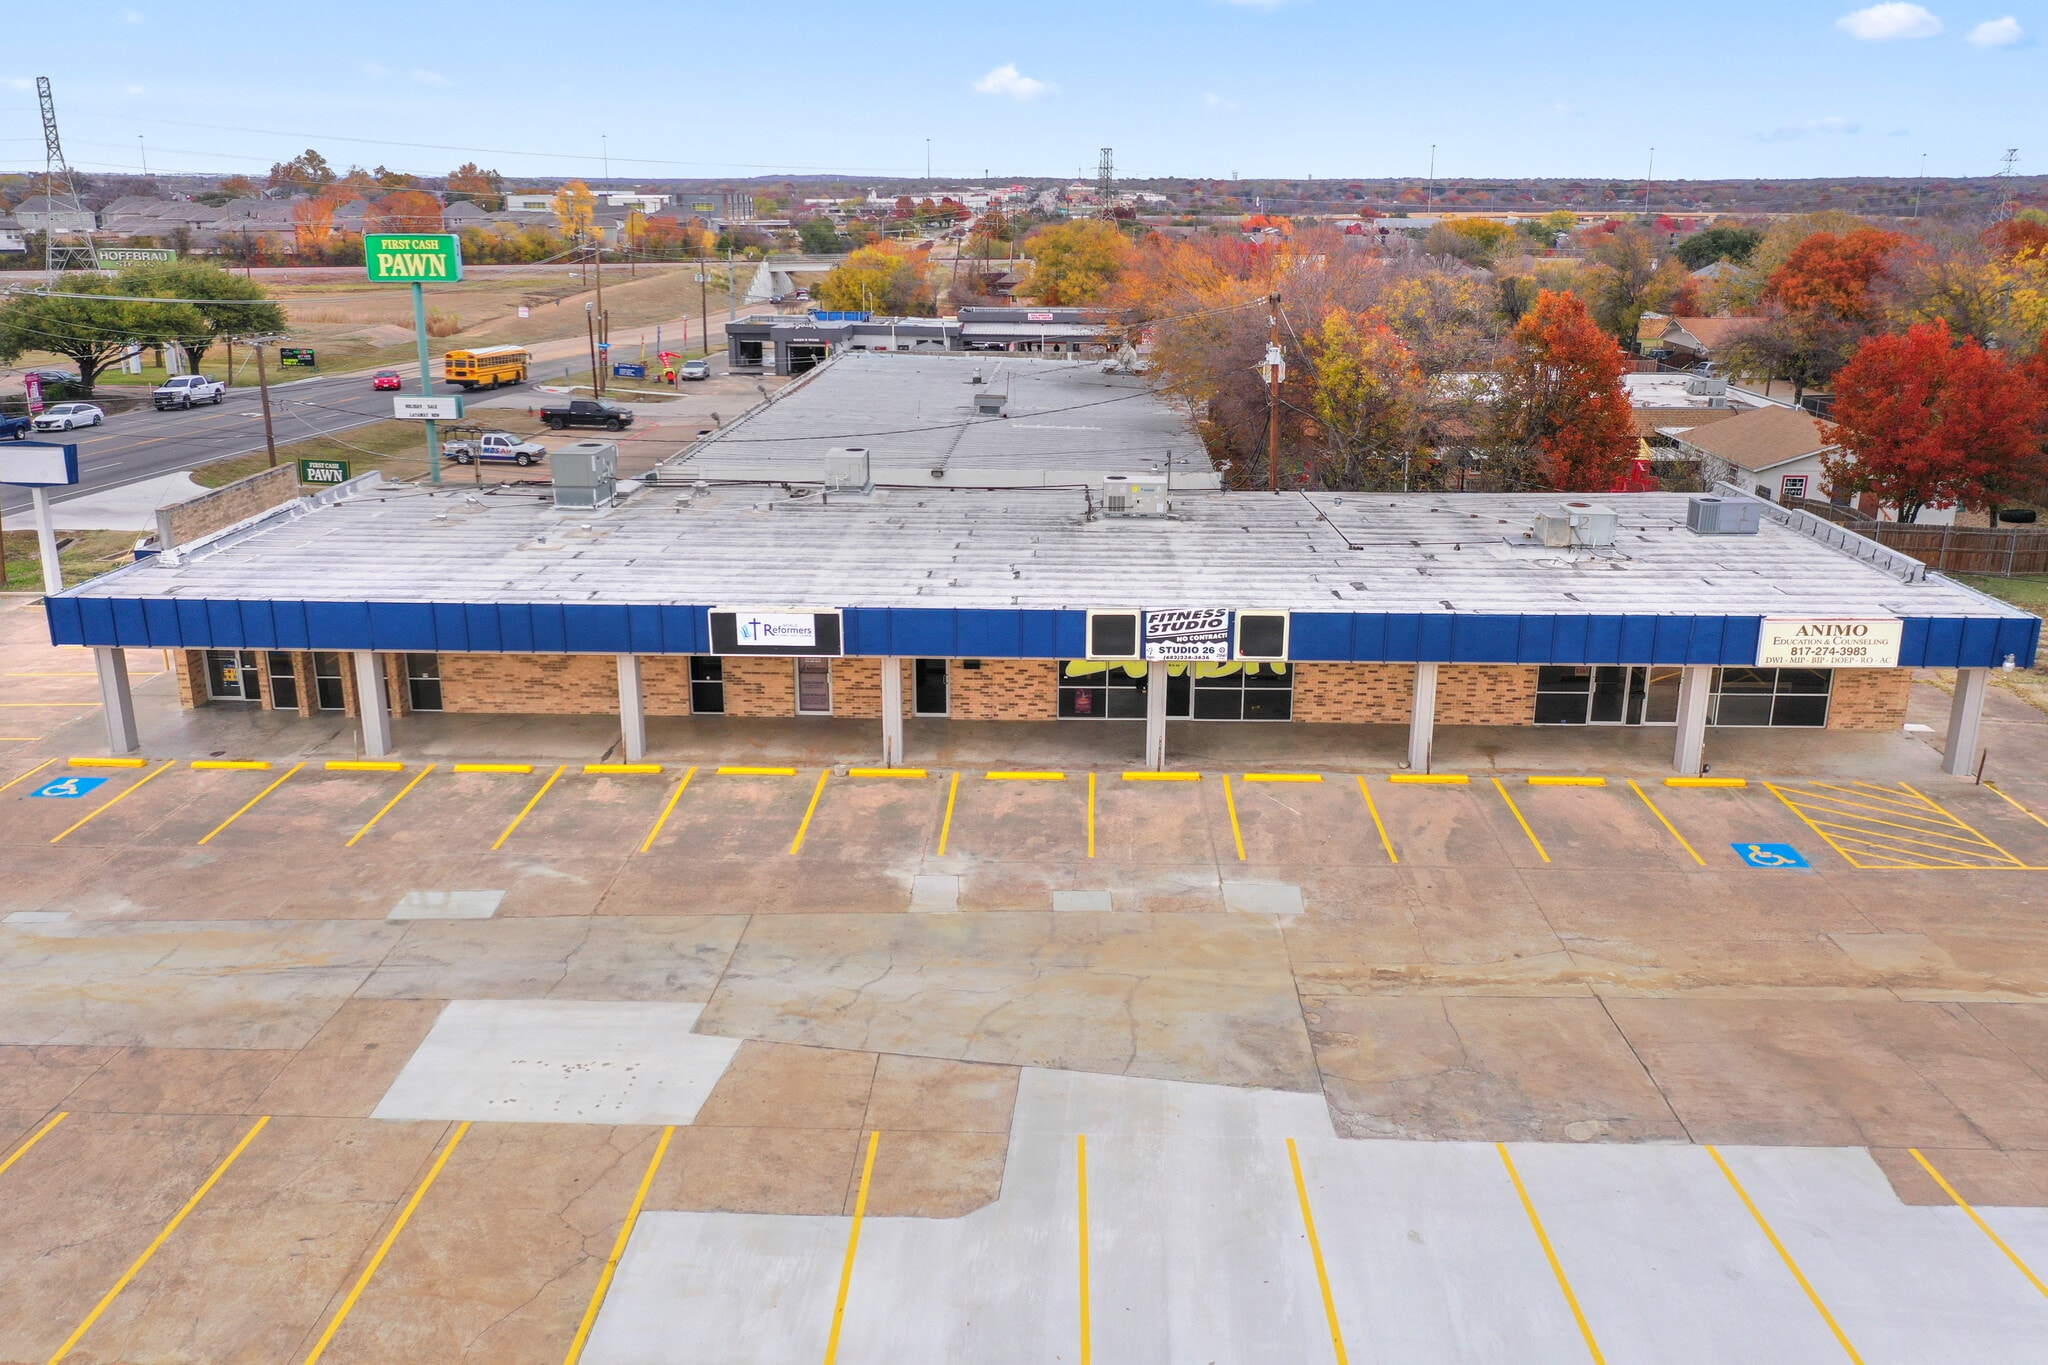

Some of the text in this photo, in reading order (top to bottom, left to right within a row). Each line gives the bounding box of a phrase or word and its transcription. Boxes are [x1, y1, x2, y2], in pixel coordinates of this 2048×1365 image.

[381, 239, 440, 250] FIRST CASH
[99, 251, 168, 261] HOFFBRAU
[377, 253, 446, 277] PAWN
[306, 468, 343, 482] PAWN
[1578, 516, 1590, 530] 2
[1148, 608, 1227, 623] FITNESS
[764, 624, 812, 636] Reformers
[1148, 619, 1223, 633] STUDIO
[1795, 624, 1869, 637] ANIMO
[1189, 632, 1228, 641] CONTRACT!
[1773, 636, 1821, 646] EDUCATION
[1832, 637, 1889, 645] COUNSELING
[1158, 646, 1215, 654] STUDIO 26
[1790, 646, 1867, 656] 817-274-3983
[1765, 656, 1784, 664] DWI
[1789, 656, 1806, 664] MIP
[1811, 656, 1825, 664] BIP
[1831, 656, 1855, 664] DOEP
[1860, 656, 1873, 664] RO
[1879, 656, 1892, 664] AC
